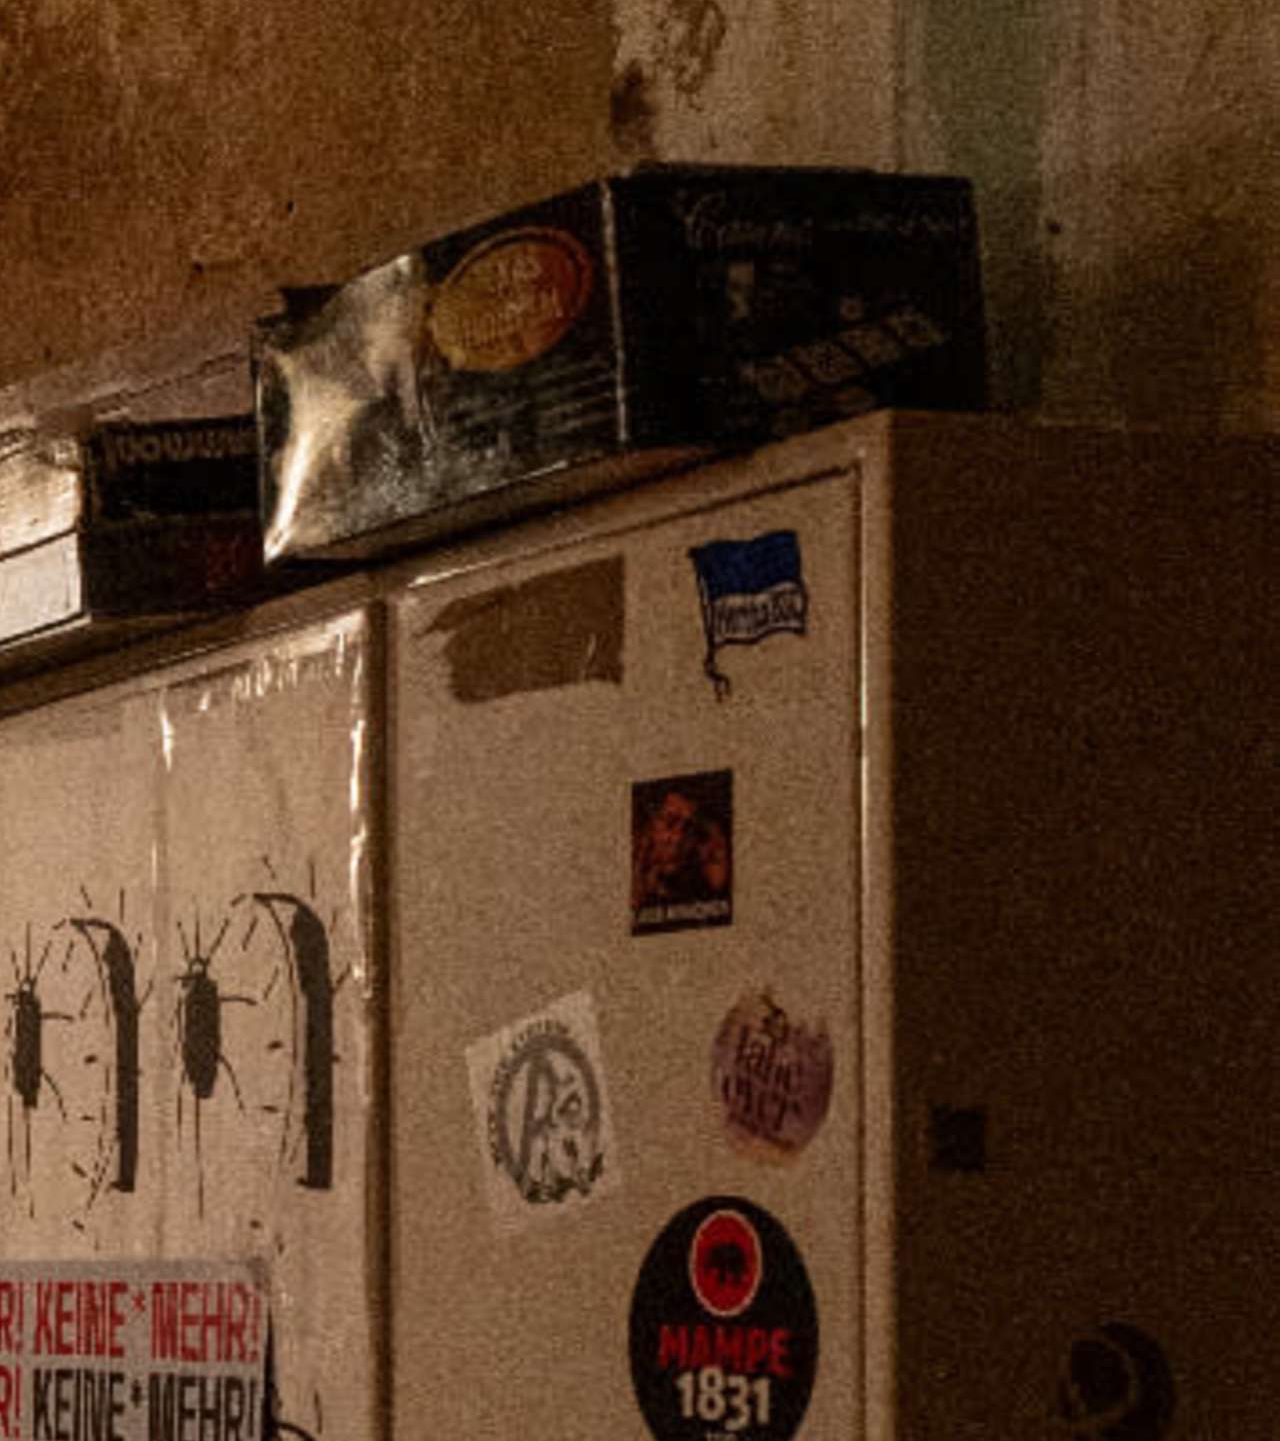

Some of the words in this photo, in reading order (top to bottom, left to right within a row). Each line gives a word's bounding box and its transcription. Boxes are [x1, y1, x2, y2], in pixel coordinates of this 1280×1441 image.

[151, 1280, 260, 1363] MEHR!
[657, 1322, 795, 1381] MAMPE
[675, 1366, 772, 1432] 1831
